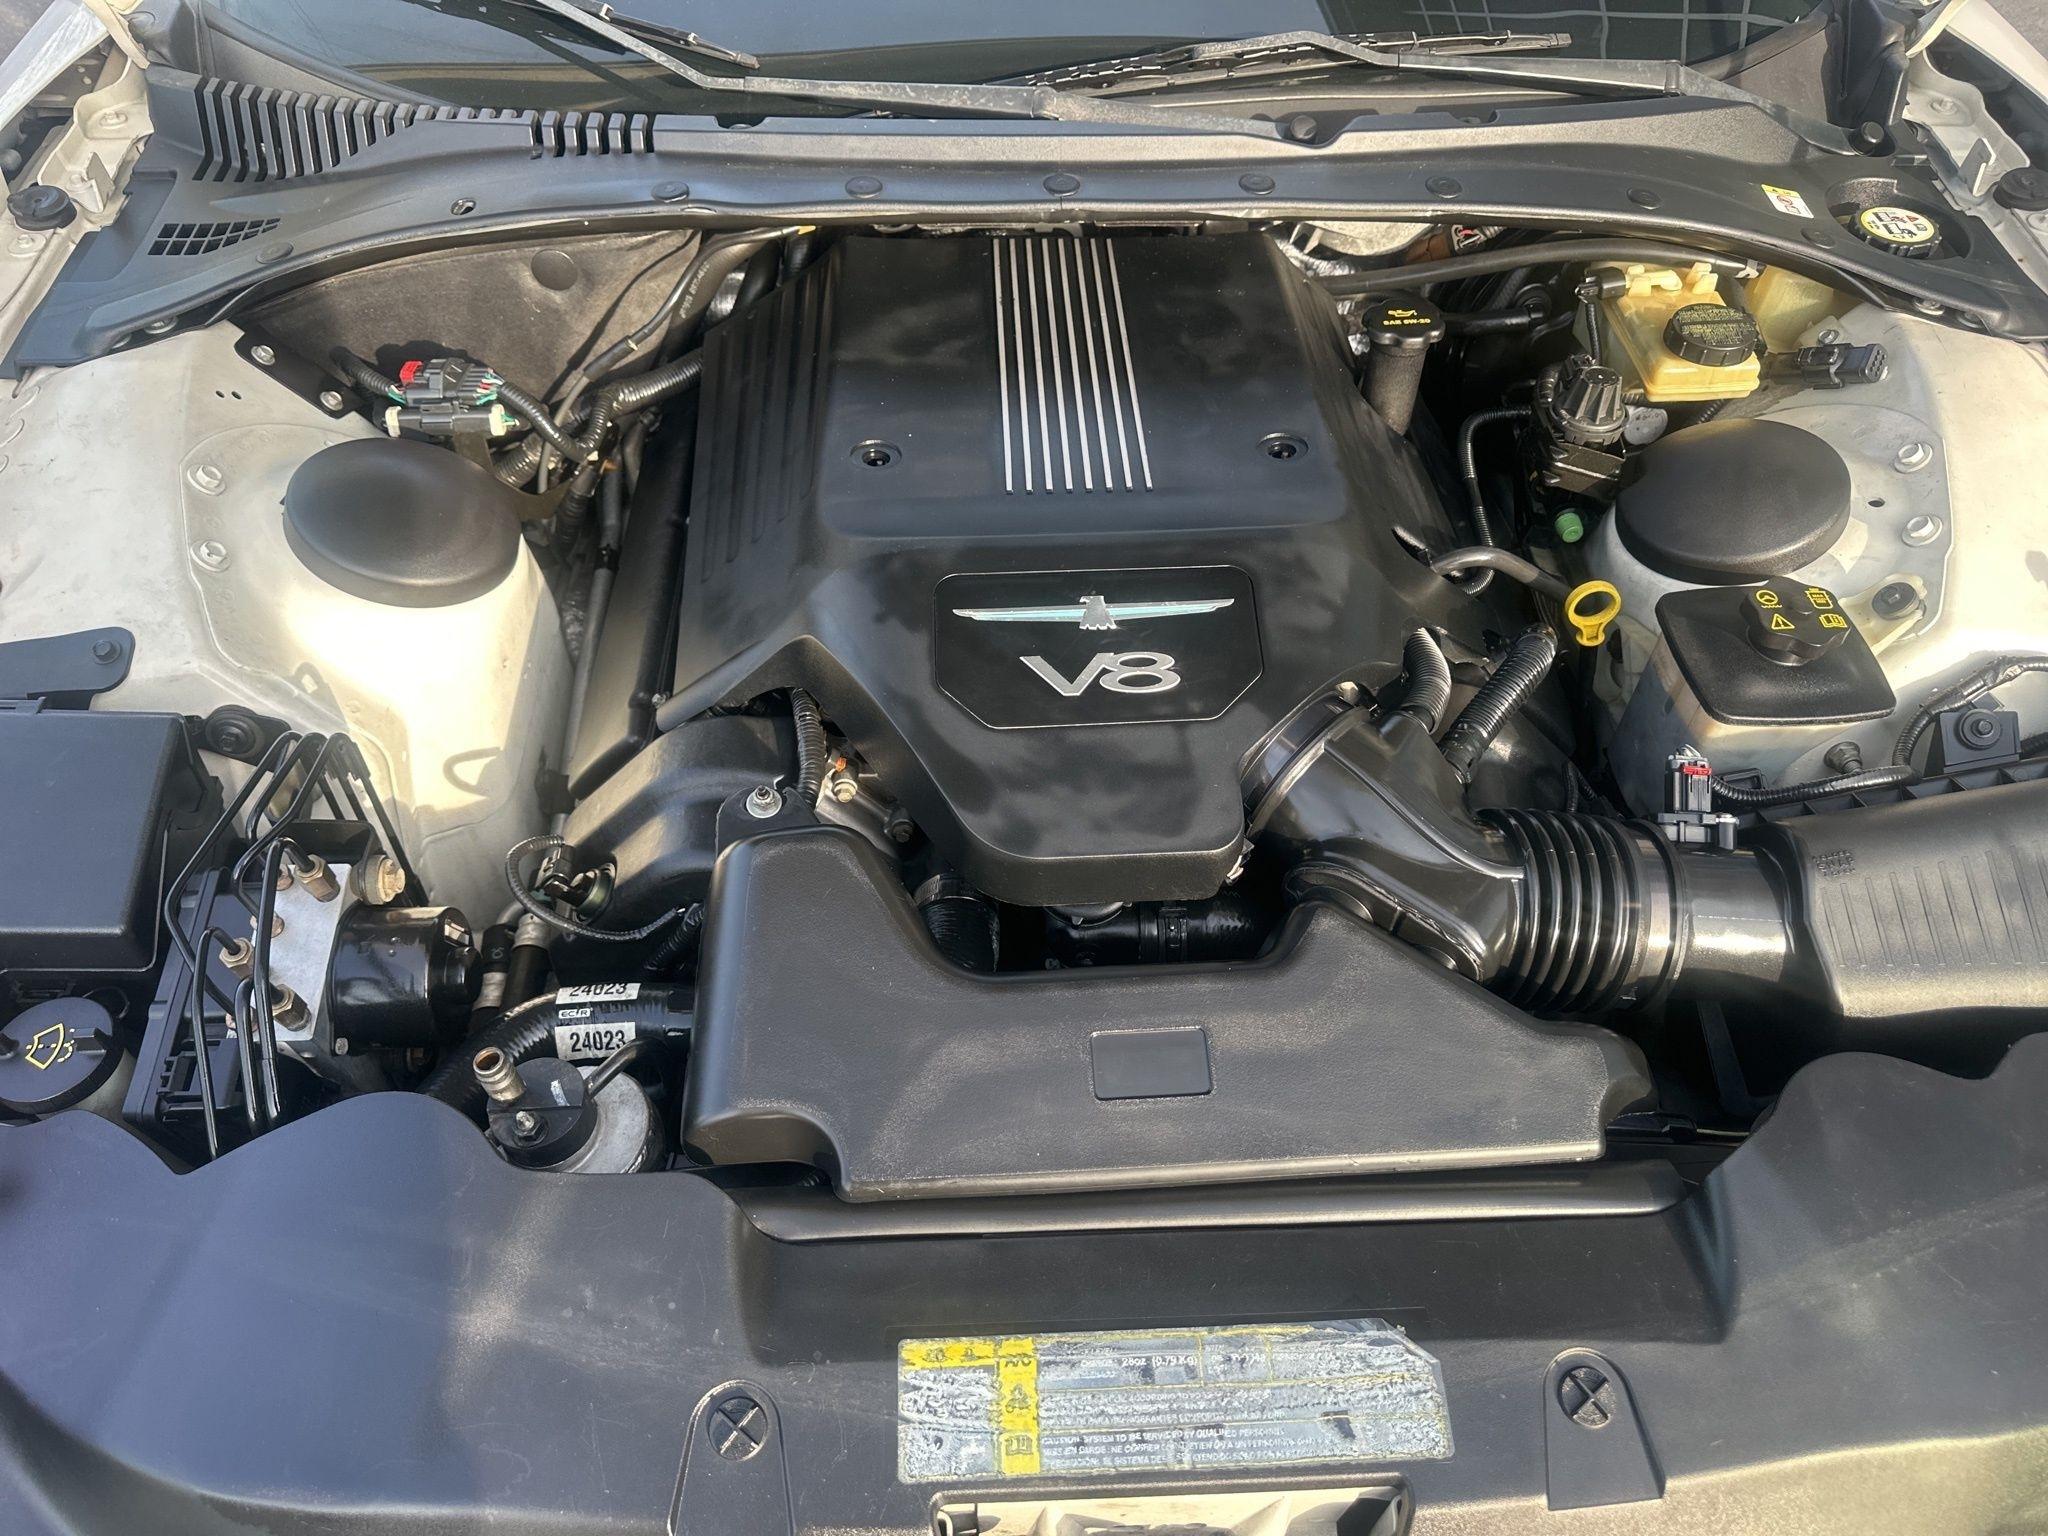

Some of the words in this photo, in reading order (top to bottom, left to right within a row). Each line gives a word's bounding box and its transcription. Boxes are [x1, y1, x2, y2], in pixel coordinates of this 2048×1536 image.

[1019, 651, 1181, 697] V8
[569, 983, 628, 997] 24023
[569, 1030, 626, 1053] 24023
